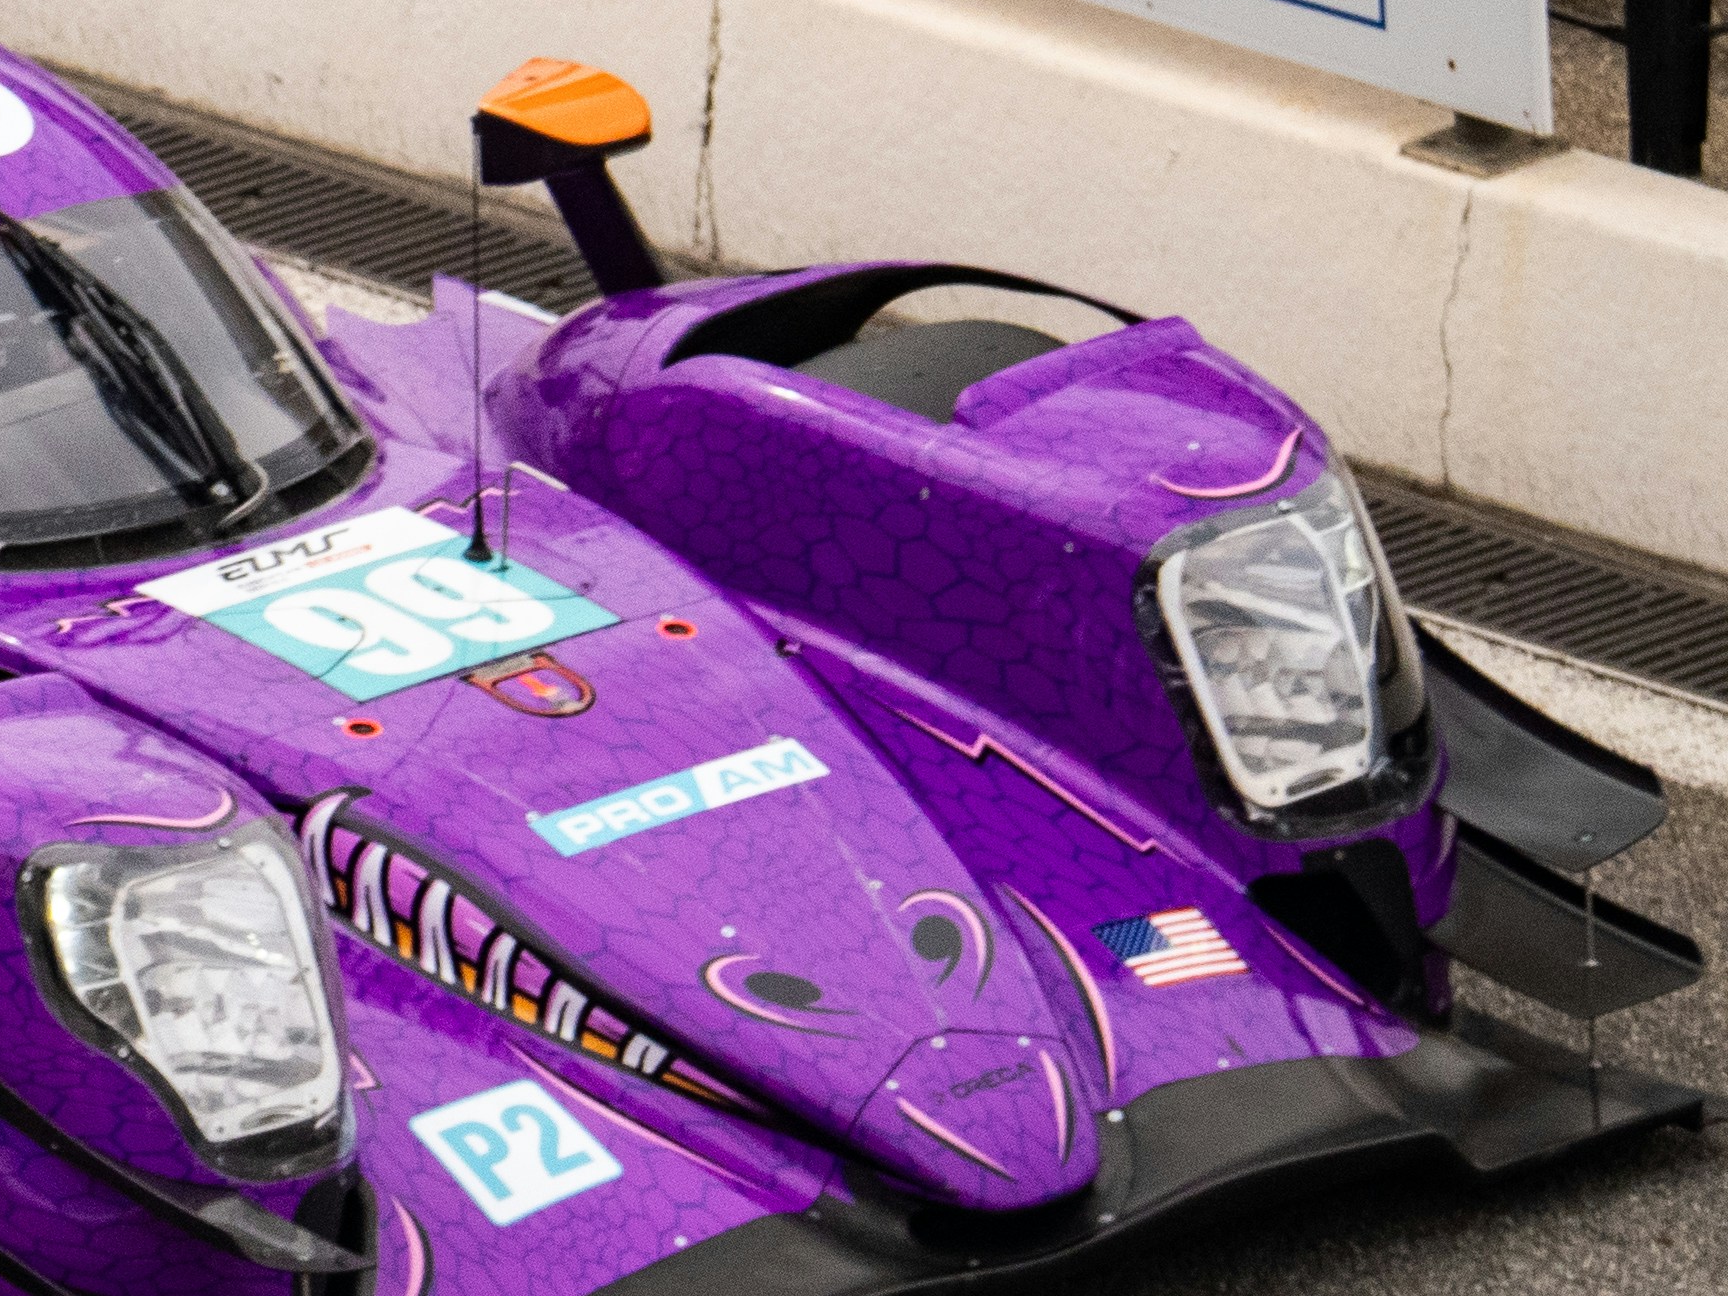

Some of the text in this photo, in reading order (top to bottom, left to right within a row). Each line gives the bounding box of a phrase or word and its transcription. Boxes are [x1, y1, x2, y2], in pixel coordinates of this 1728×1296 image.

[262, 555, 557, 676] 99
[556, 749, 816, 846] PRO AM
[438, 1103, 595, 1202] P2
